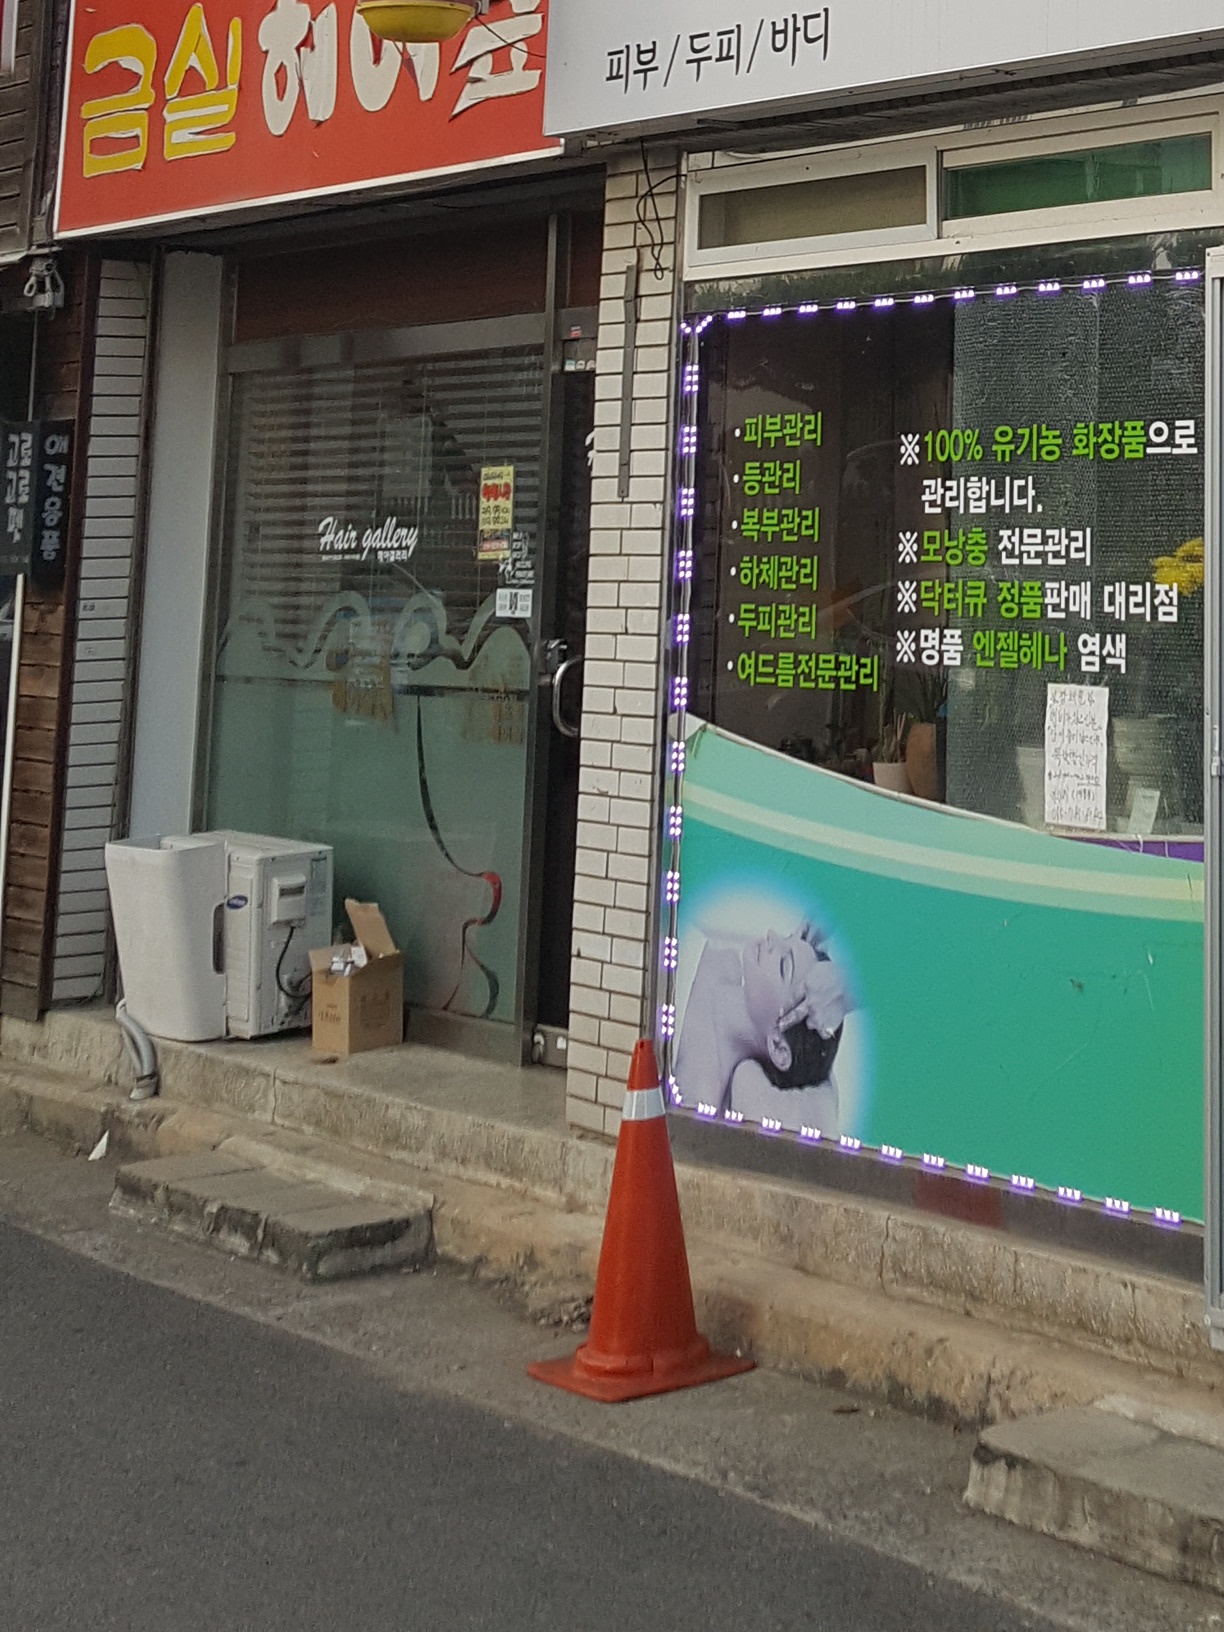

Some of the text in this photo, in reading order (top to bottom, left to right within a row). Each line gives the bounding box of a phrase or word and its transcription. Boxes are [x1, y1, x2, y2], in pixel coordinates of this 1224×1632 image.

[81, 3, 242, 178] 금실
[743, 411, 823, 449] 피부관리
[924, 419, 1198, 462] 100% 유기농 화장품으로
[742, 459, 801, 496] 등관리
[921, 475, 1043, 514] 관리합니다.
[318, 515, 419, 562] Hair gallery
[740, 507, 820, 543] 복부관리
[920, 527, 1092, 566] 모낭충 전문관리
[739, 555, 818, 591] 하체관리
[919, 579, 1179, 623] 닥터큐 정품판매 대리점
[737, 603, 817, 640] 두피관리
[919, 628, 1127, 674] 명품 엔젤헤나 염색
[737, 650, 879, 693] 여드름전문관리
